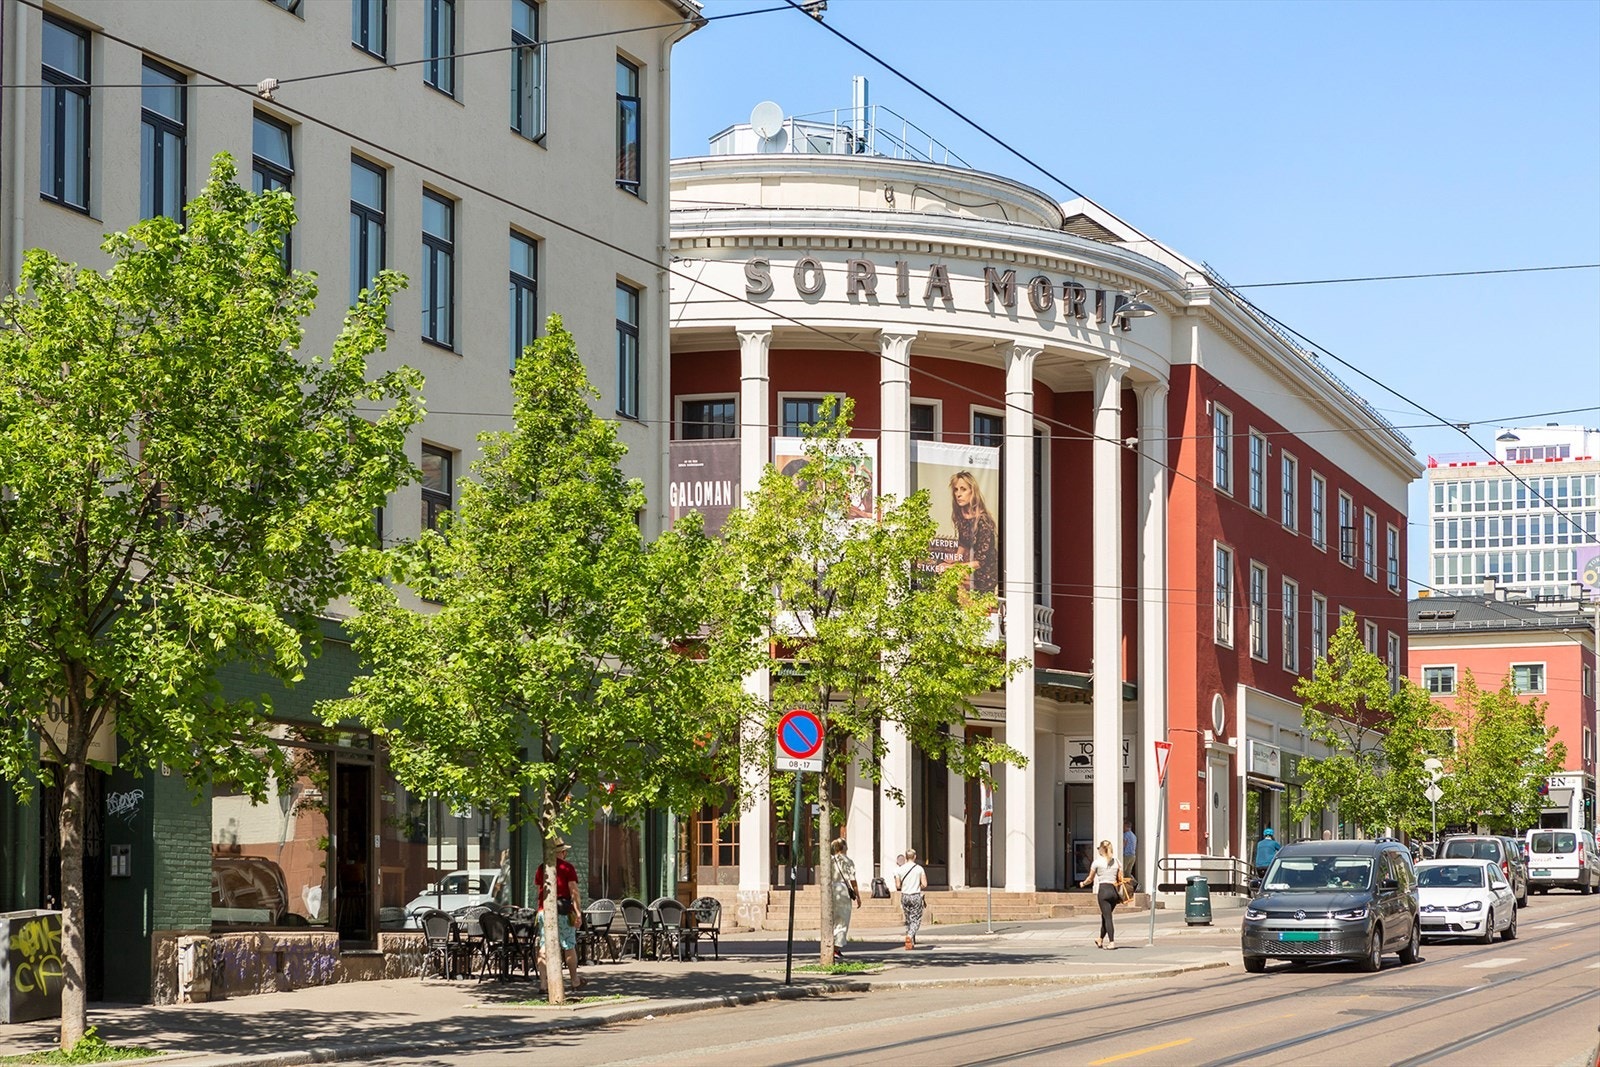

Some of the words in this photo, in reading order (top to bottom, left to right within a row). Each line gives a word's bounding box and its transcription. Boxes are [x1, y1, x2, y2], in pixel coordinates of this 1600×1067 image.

[744, 255, 953, 301] SORIA
[670, 481, 731, 507] GALOMAN
[930, 539, 958, 548] VERDEN
[928, 551, 964, 561] SVINNER
